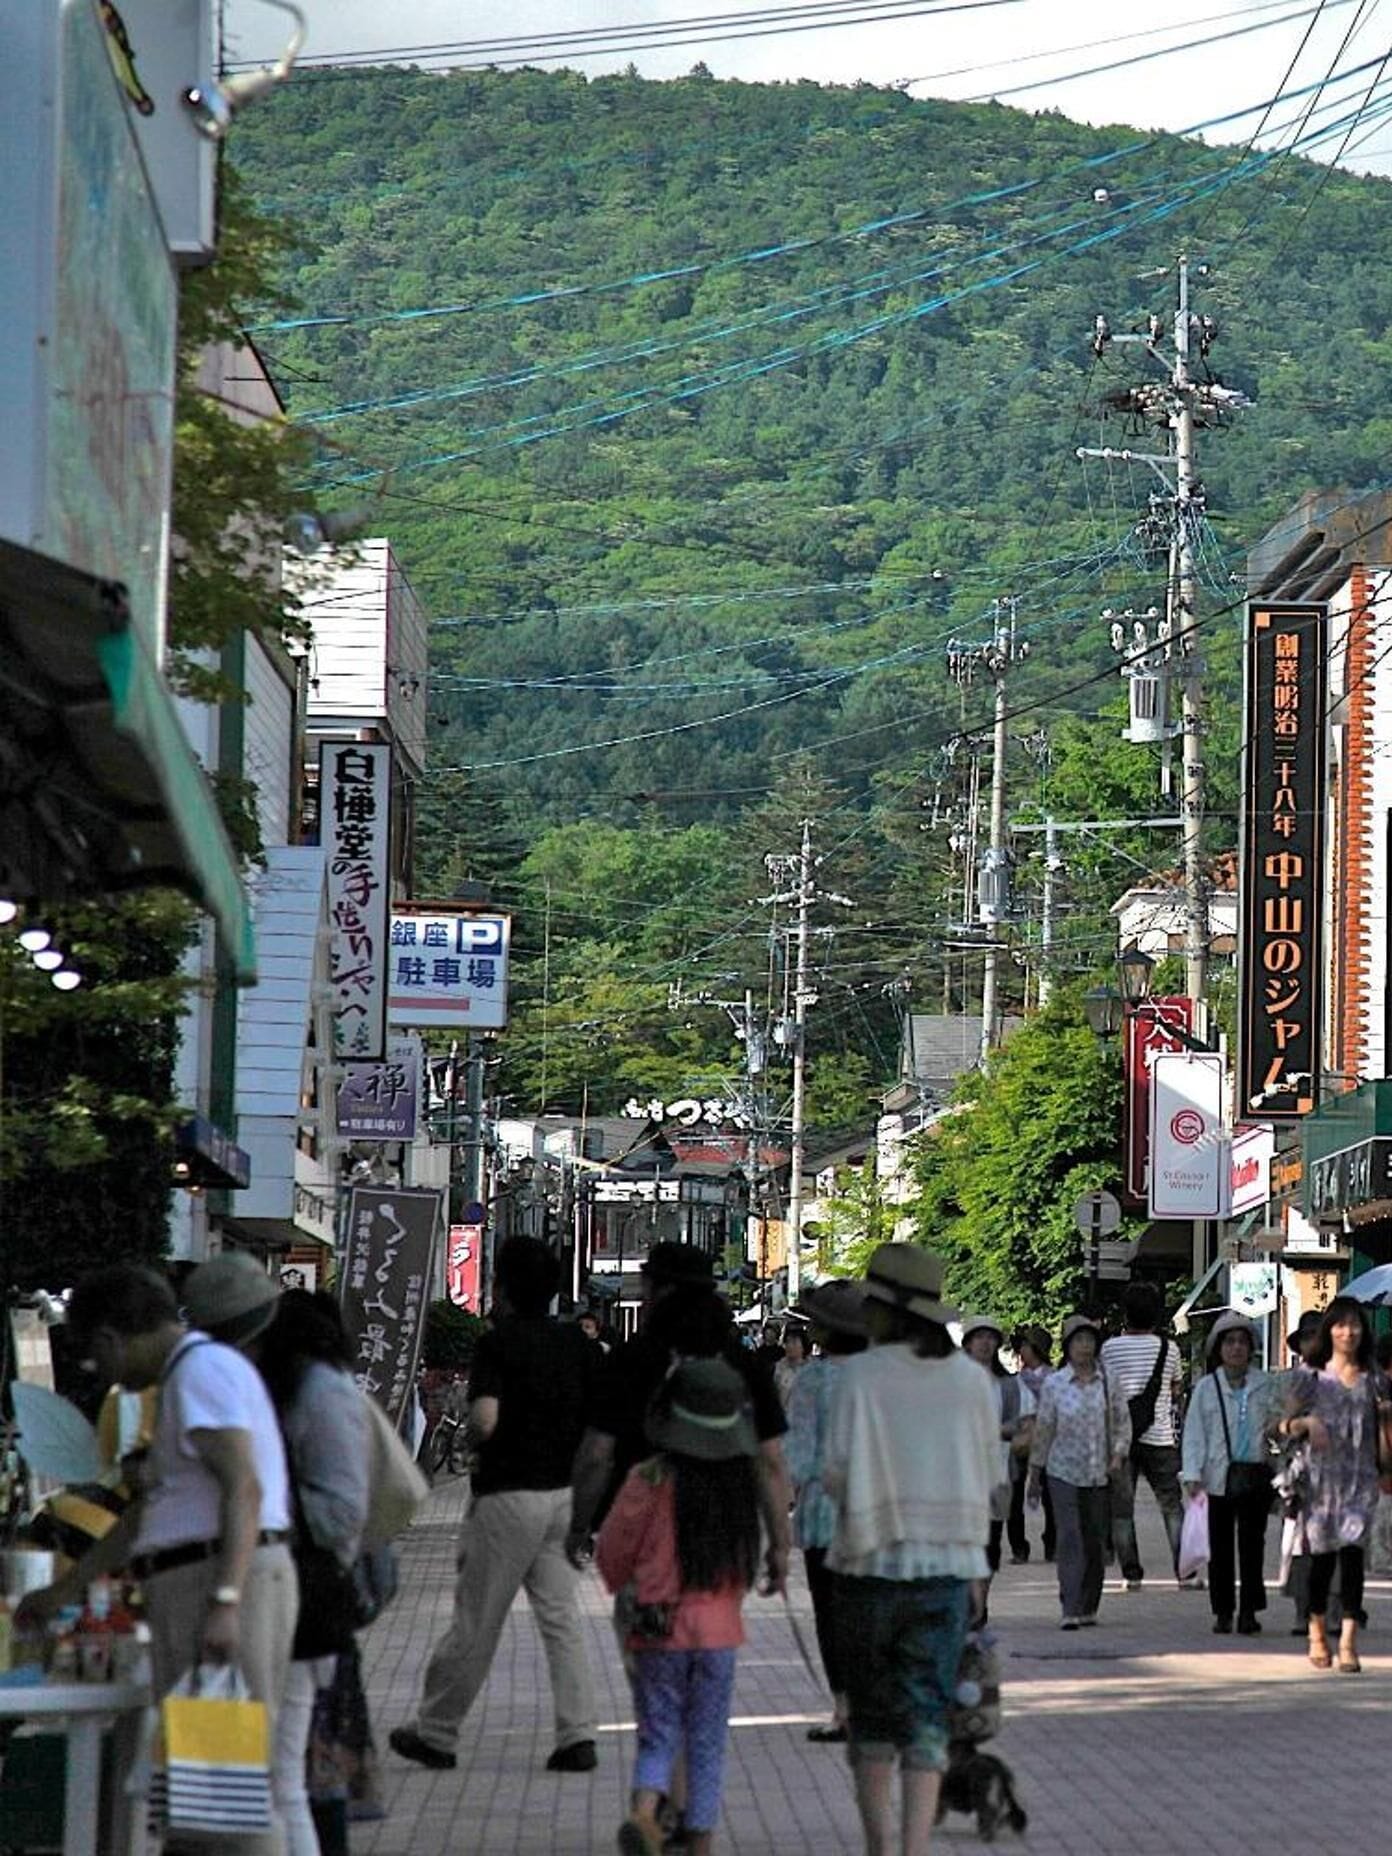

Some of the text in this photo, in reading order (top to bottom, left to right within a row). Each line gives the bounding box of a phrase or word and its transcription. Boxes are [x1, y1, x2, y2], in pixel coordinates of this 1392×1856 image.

[1273, 633, 1299, 838] 創業明治三十八年
[391, 919, 500, 951] 銀座 P
[397, 957, 496, 988] 駐車場
[1263, 851, 1302, 1093] 中山のジャム
